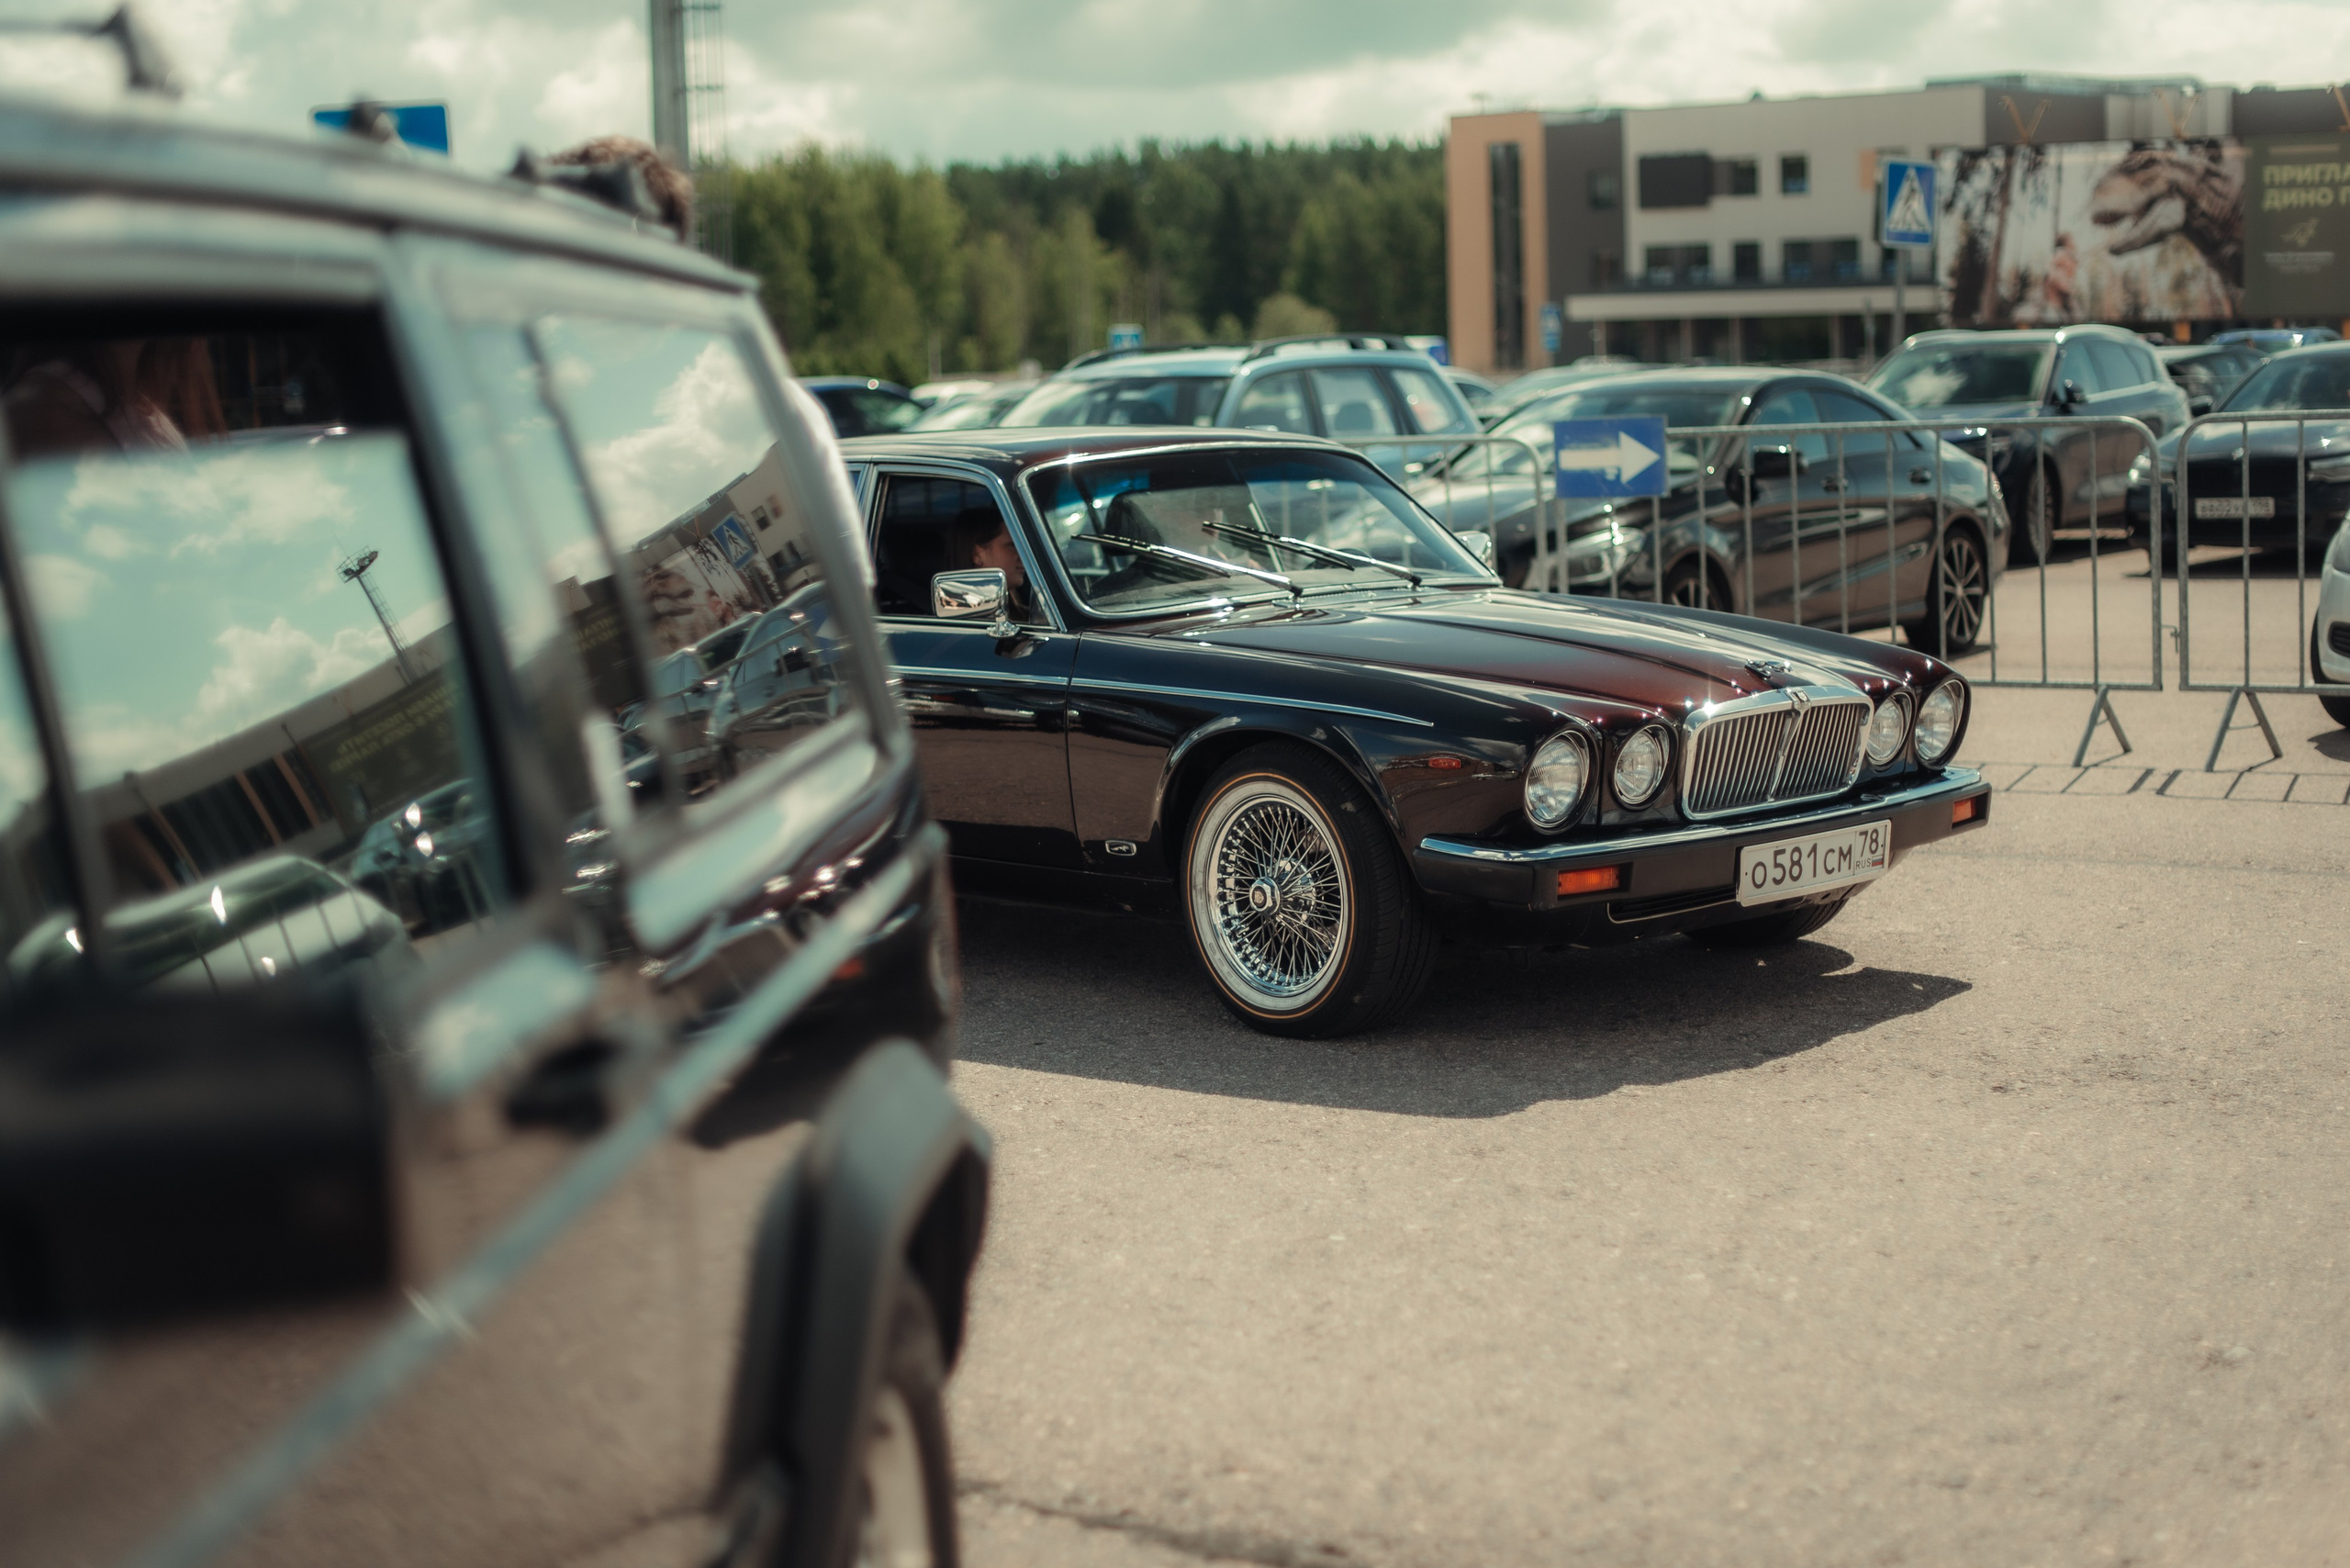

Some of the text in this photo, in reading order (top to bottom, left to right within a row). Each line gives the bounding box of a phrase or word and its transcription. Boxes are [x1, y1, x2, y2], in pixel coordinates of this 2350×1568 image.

[2261, 186, 2333, 211] ДИНО
[1858, 828, 1879, 857] 78
[1856, 857, 1872, 870] RUS
